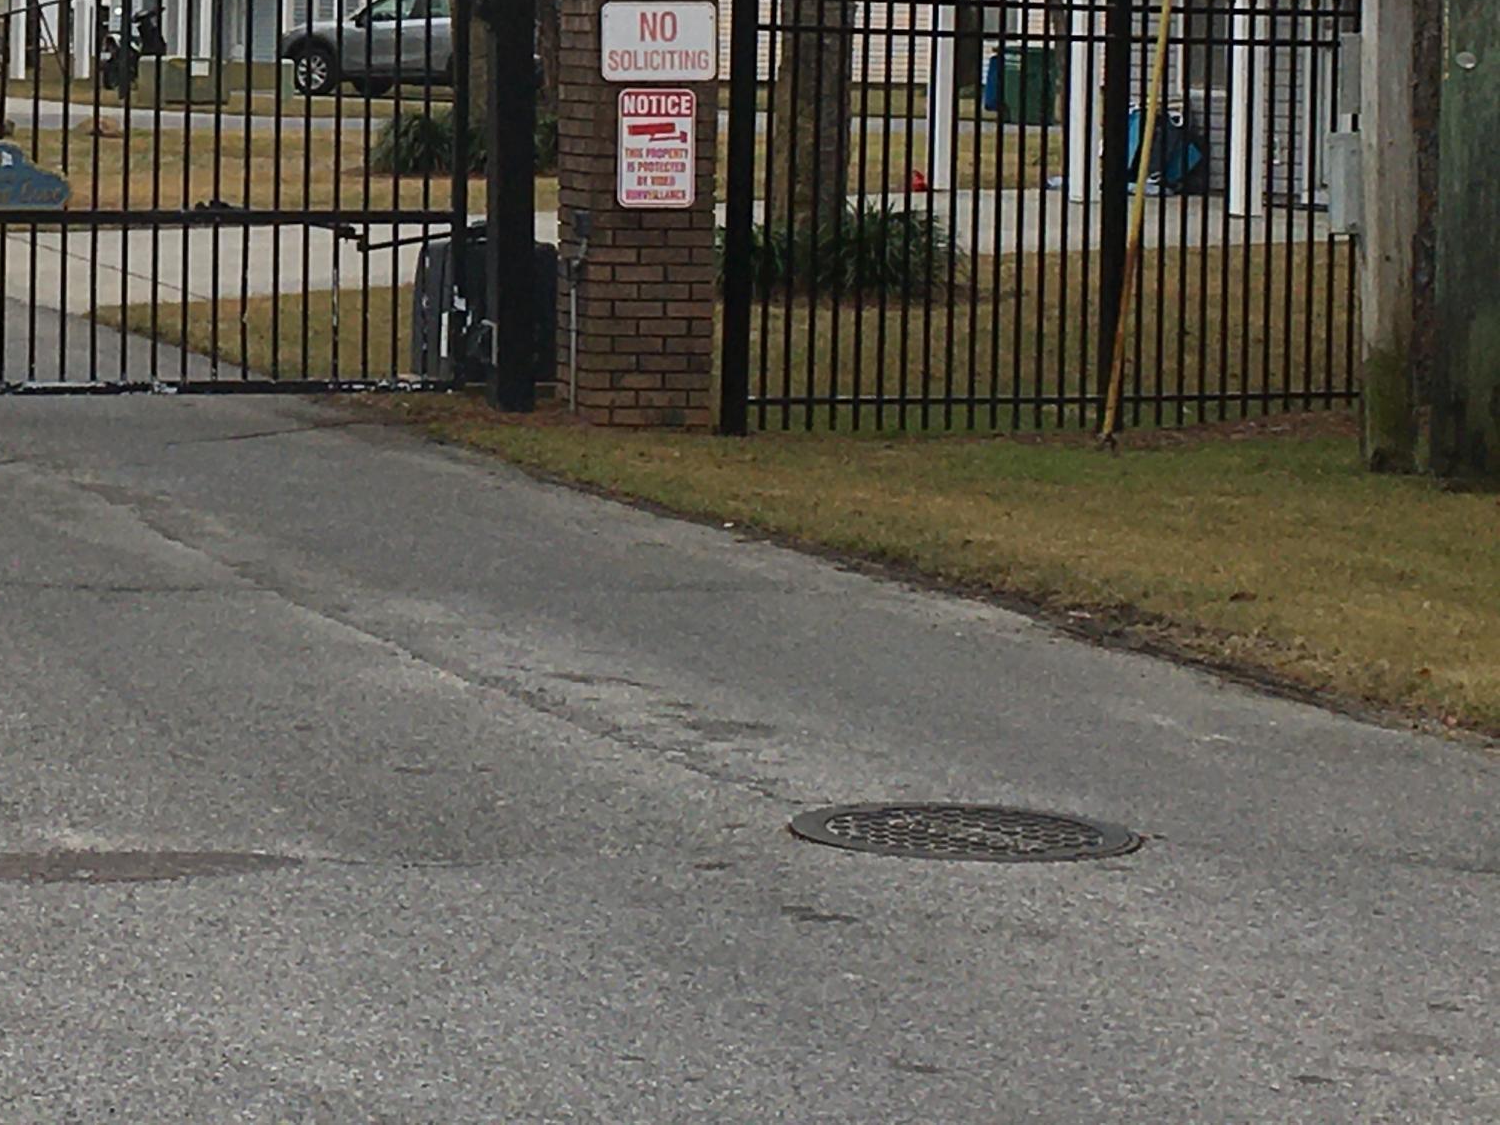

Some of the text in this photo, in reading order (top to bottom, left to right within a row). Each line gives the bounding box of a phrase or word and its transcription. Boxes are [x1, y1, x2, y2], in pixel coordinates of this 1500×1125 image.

[639, 11, 677, 42] NO
[608, 50, 709, 71] SOLICITING
[623, 95, 691, 115] NOTICE
[638, 162, 686, 172] PROTECTED
